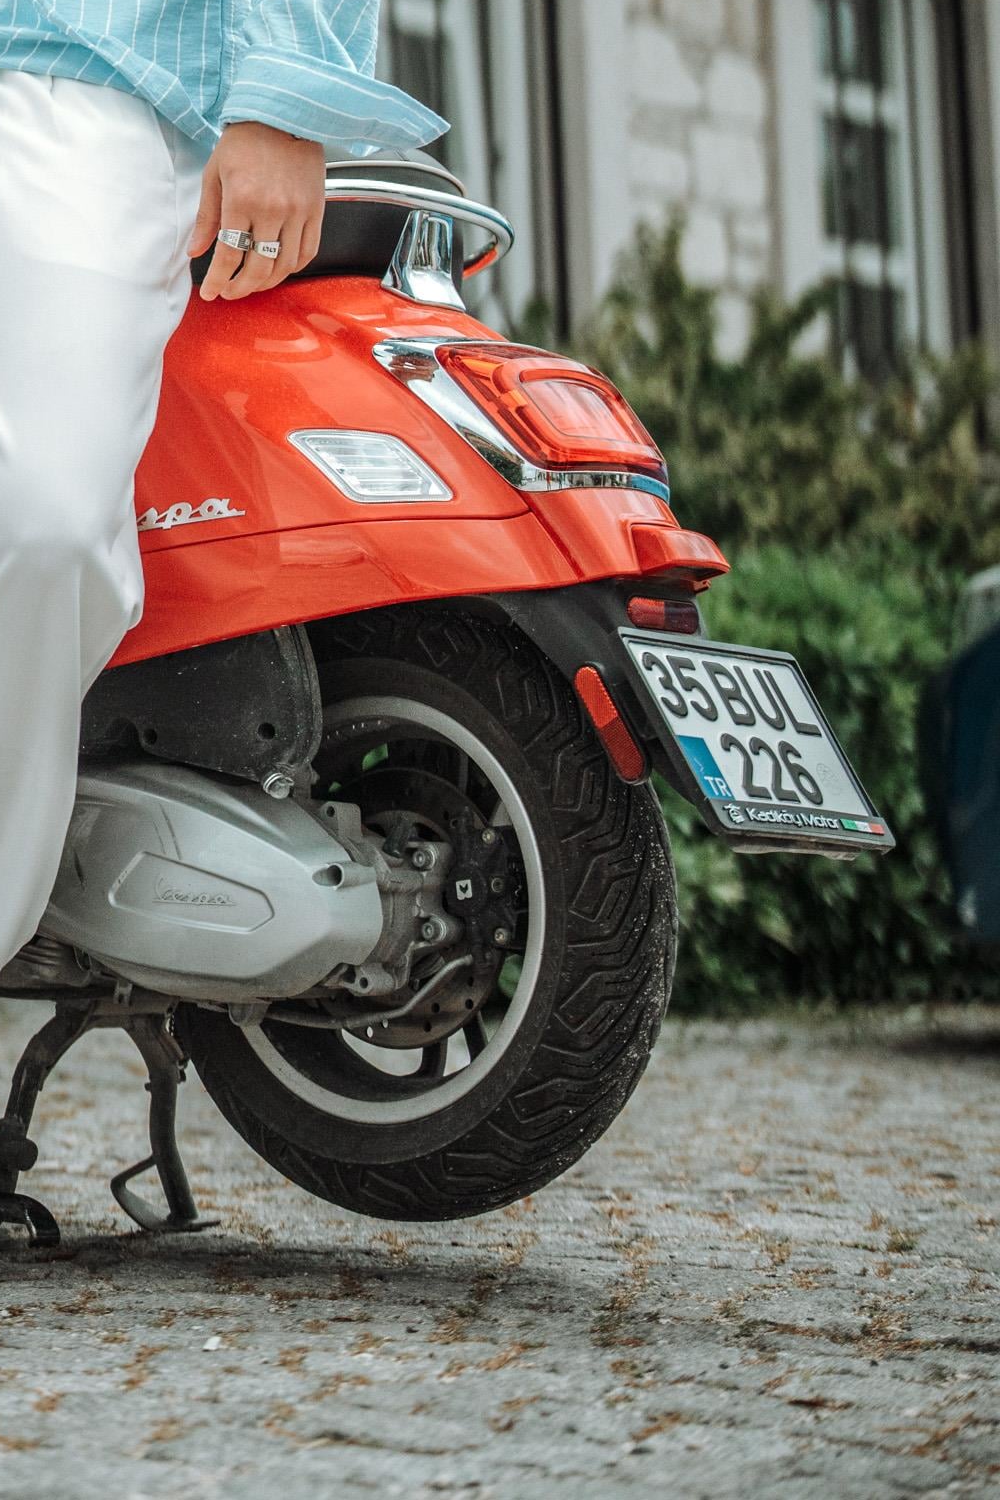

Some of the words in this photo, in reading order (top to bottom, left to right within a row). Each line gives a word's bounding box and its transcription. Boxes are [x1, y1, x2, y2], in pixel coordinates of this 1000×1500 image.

[720, 732, 824, 805] 226
[704, 775, 732, 798] TR
[801, 812, 840, 830] Motor
